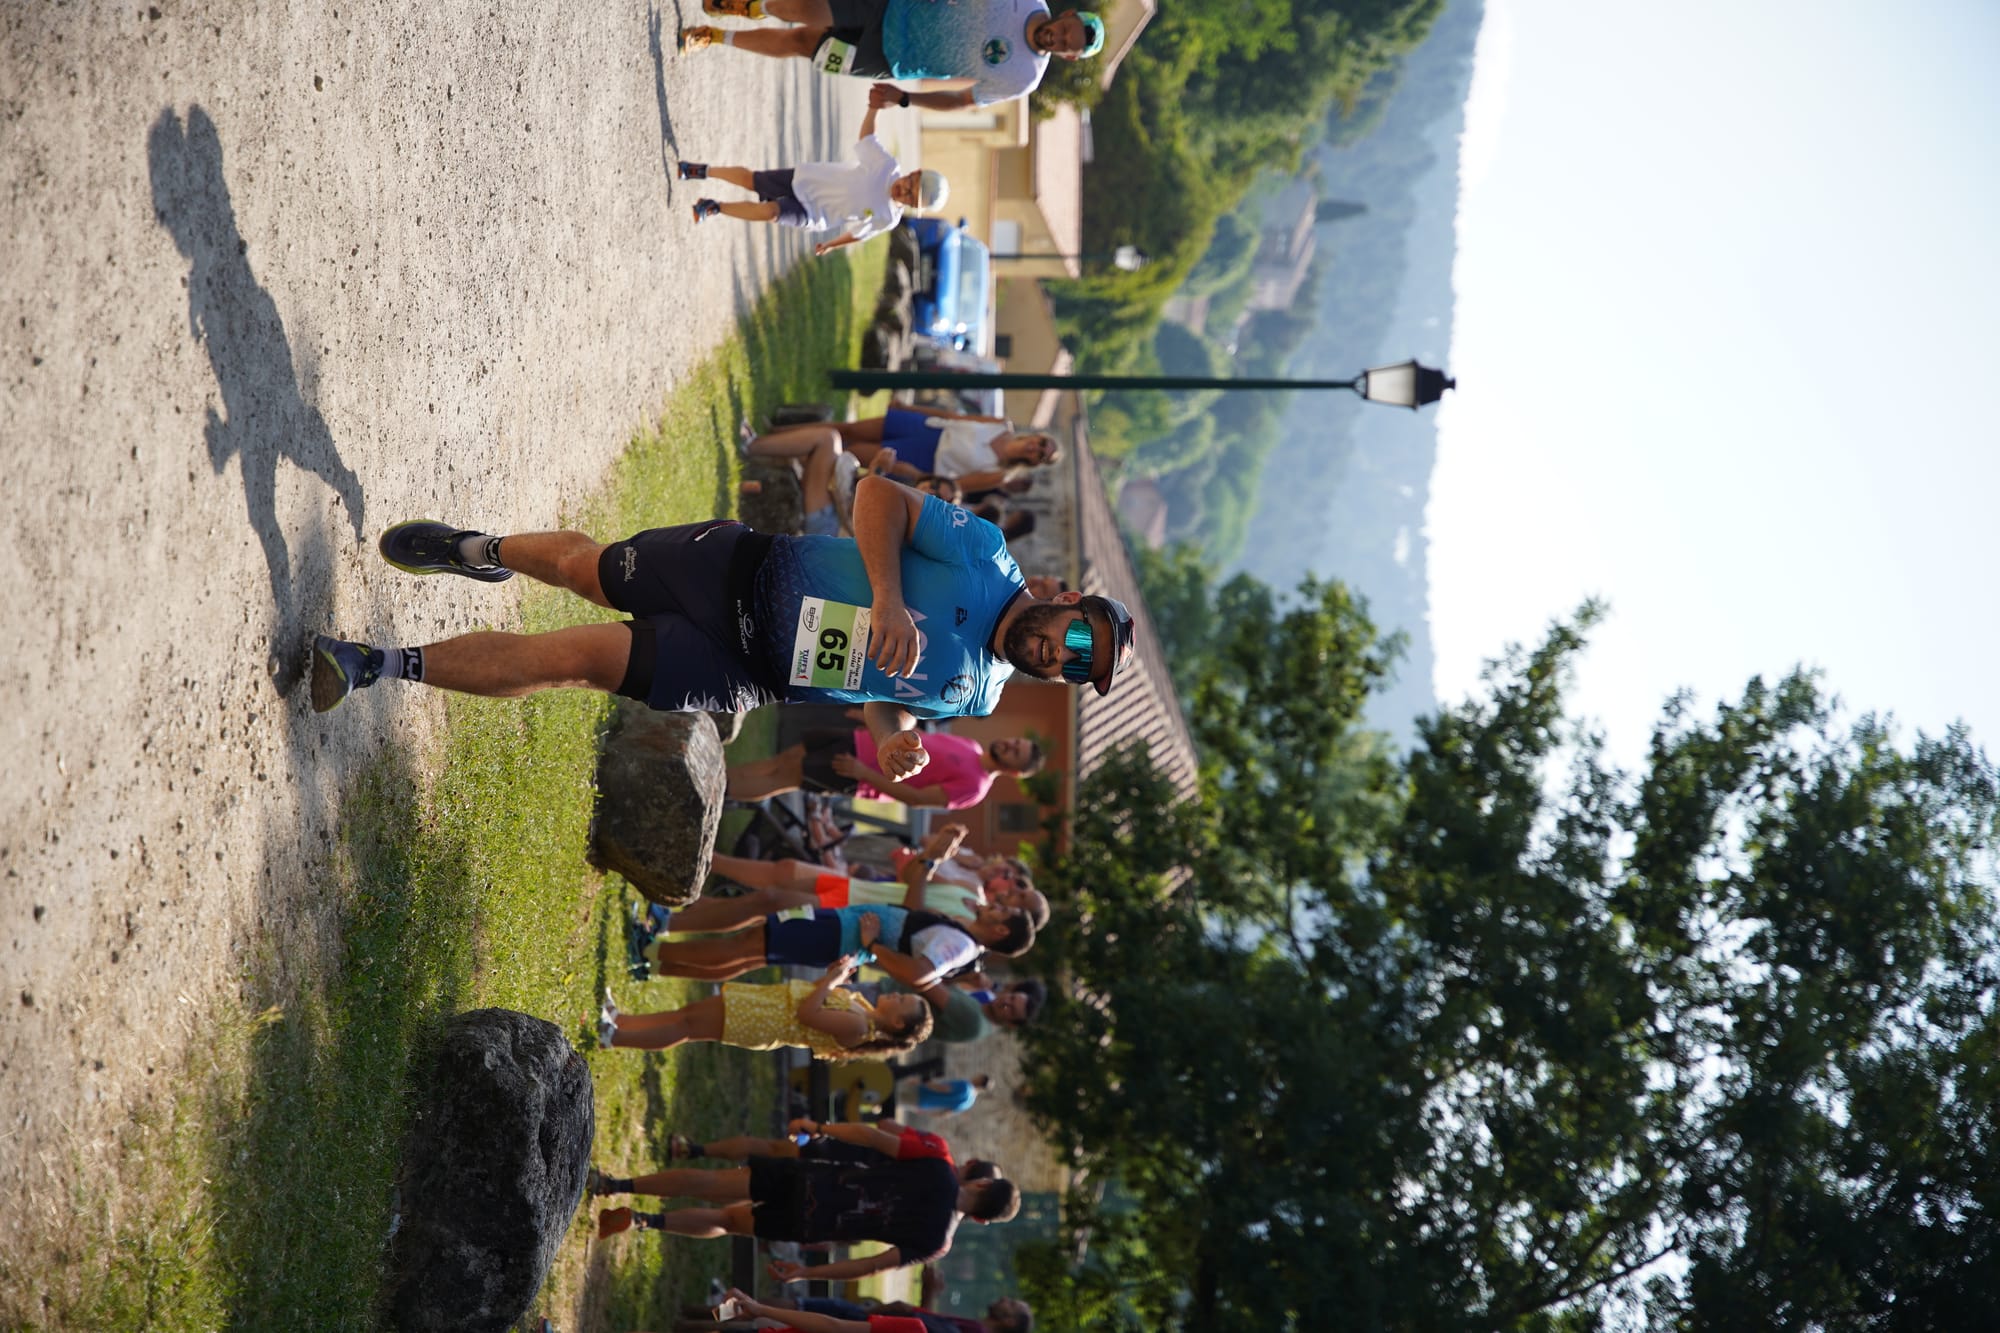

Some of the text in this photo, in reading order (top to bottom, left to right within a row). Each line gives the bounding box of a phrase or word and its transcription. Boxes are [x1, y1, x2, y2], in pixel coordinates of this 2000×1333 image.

[824, 52, 843, 73] 83
[738, 617, 750, 655] SPORT
[816, 628, 848, 672] 65
